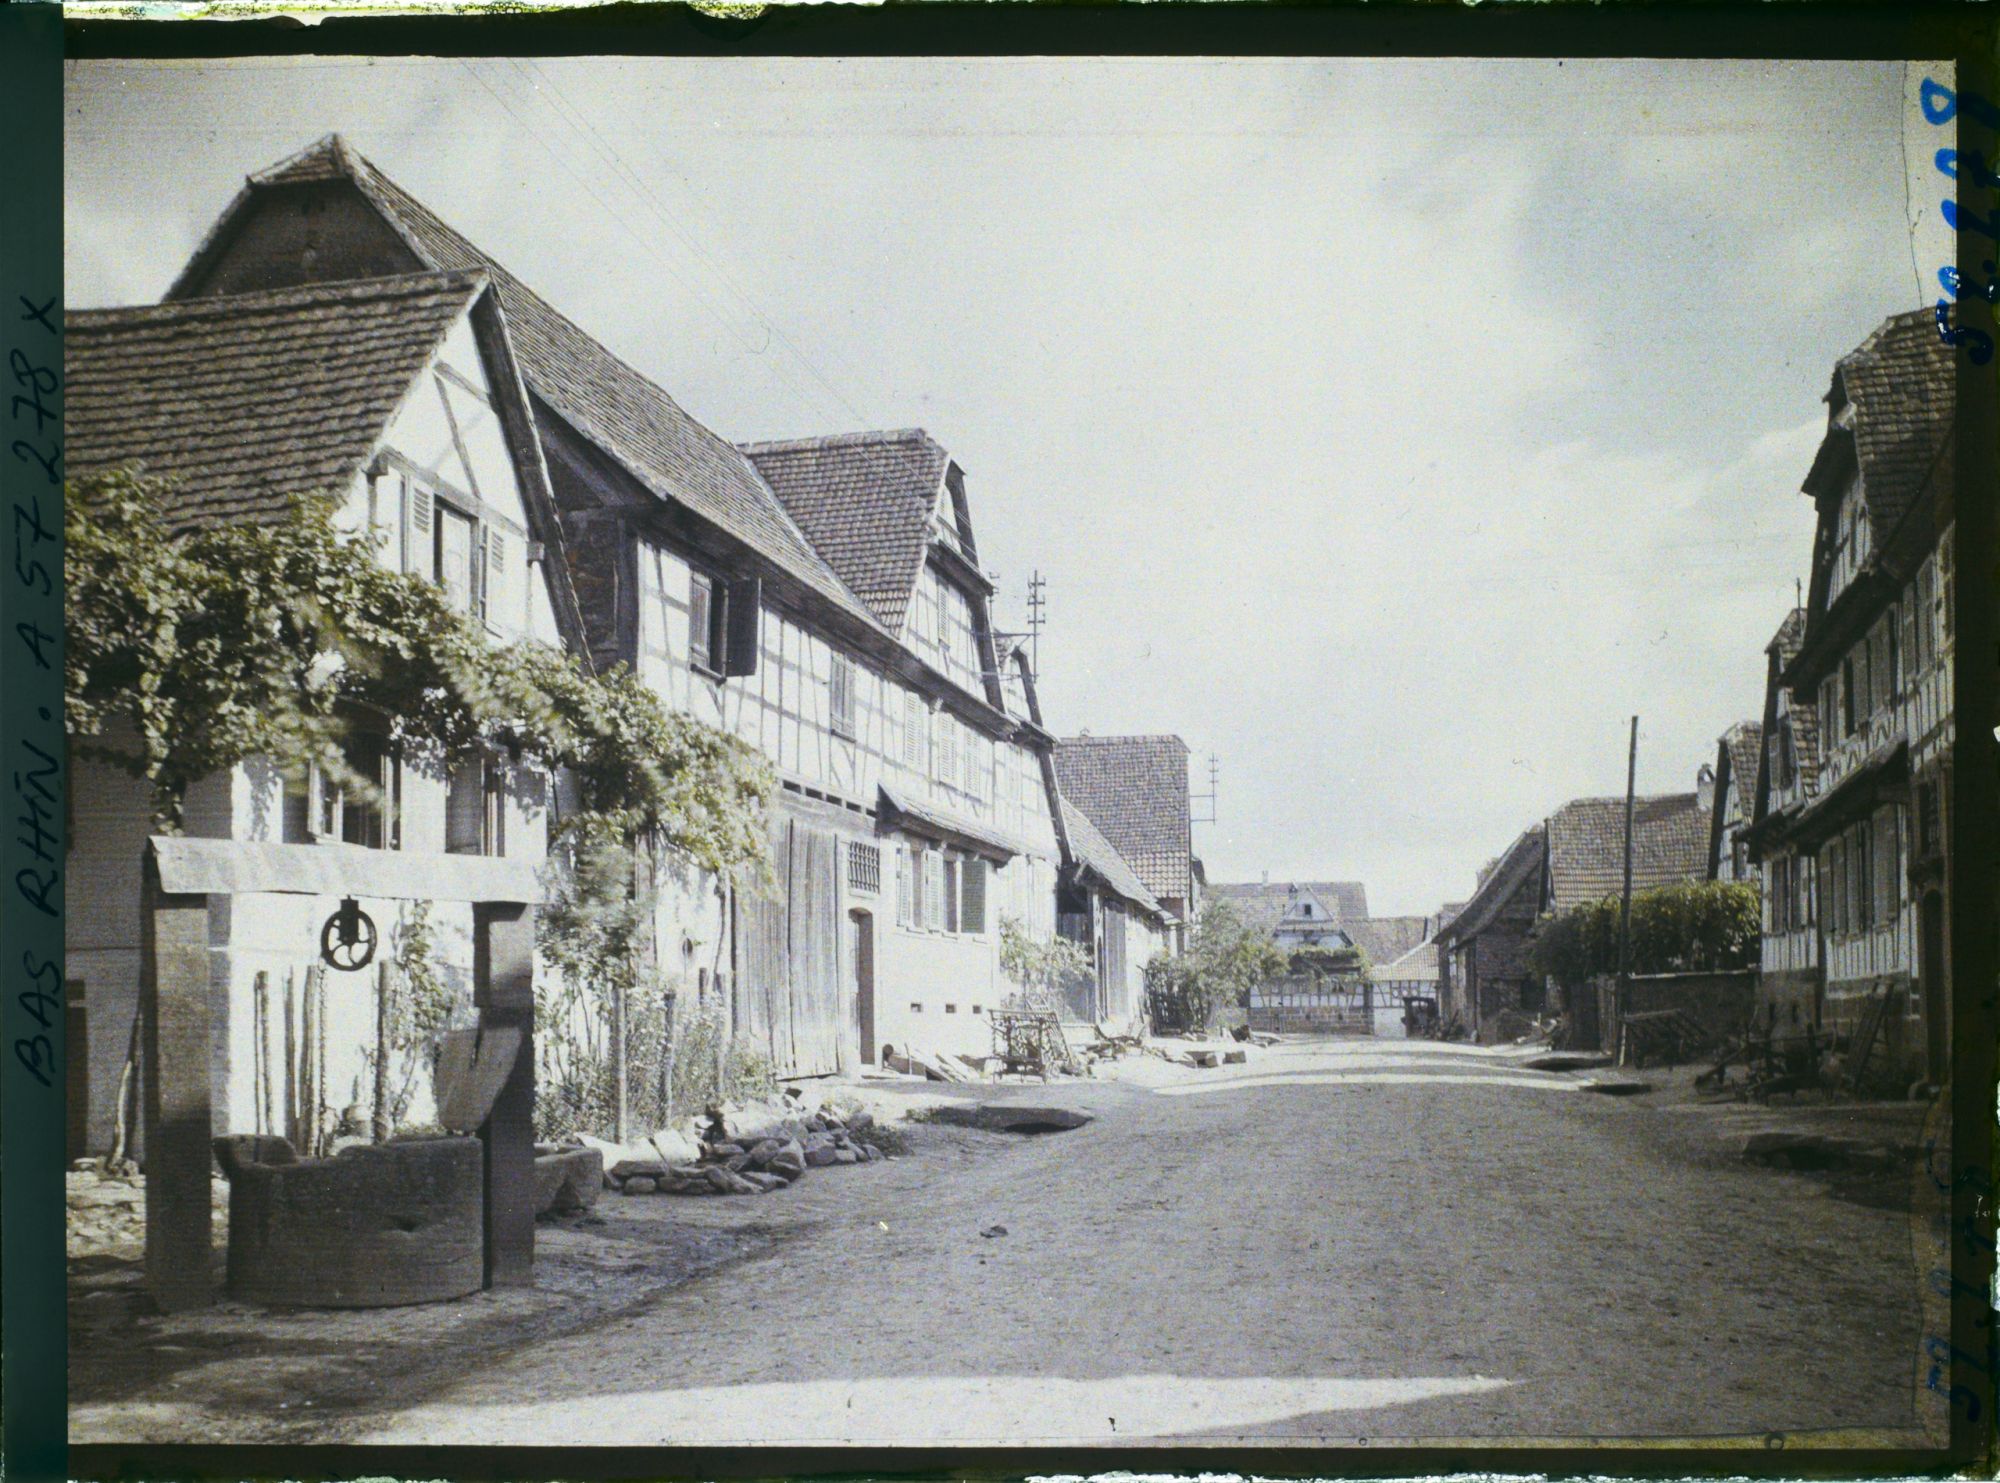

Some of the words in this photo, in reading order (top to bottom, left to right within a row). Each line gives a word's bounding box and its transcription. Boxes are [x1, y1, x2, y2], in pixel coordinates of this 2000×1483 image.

[10, 348, 61, 485] 278
[14, 495, 56, 597] 57
[15, 622, 55, 670] A
[15, 950, 61, 1087] BAS
